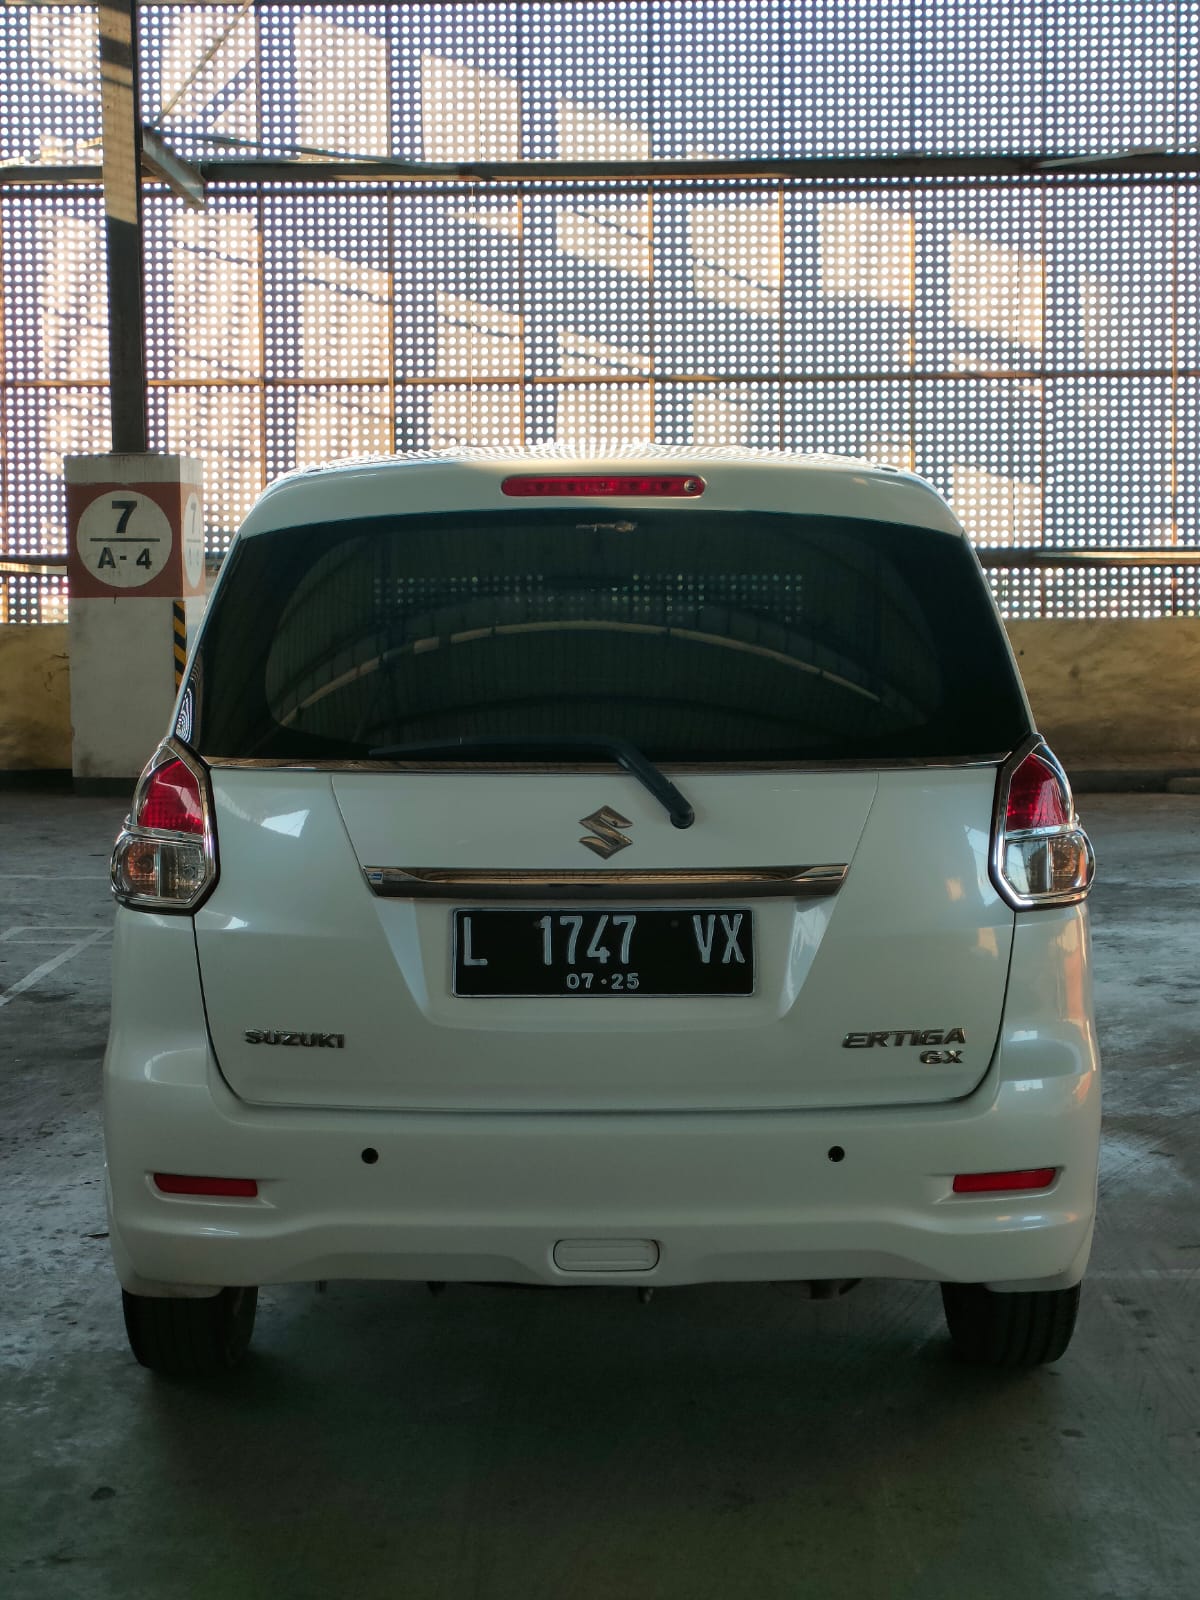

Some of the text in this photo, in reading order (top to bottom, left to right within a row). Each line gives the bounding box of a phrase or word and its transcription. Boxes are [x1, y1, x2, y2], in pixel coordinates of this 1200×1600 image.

[112, 501, 137, 533] 7
[463, 914, 746, 966] L 1747 VX
[245, 1029, 345, 1048] SUZUKI
[842, 1027, 966, 1048] ERTIGA
[919, 1050, 963, 1064] GX
